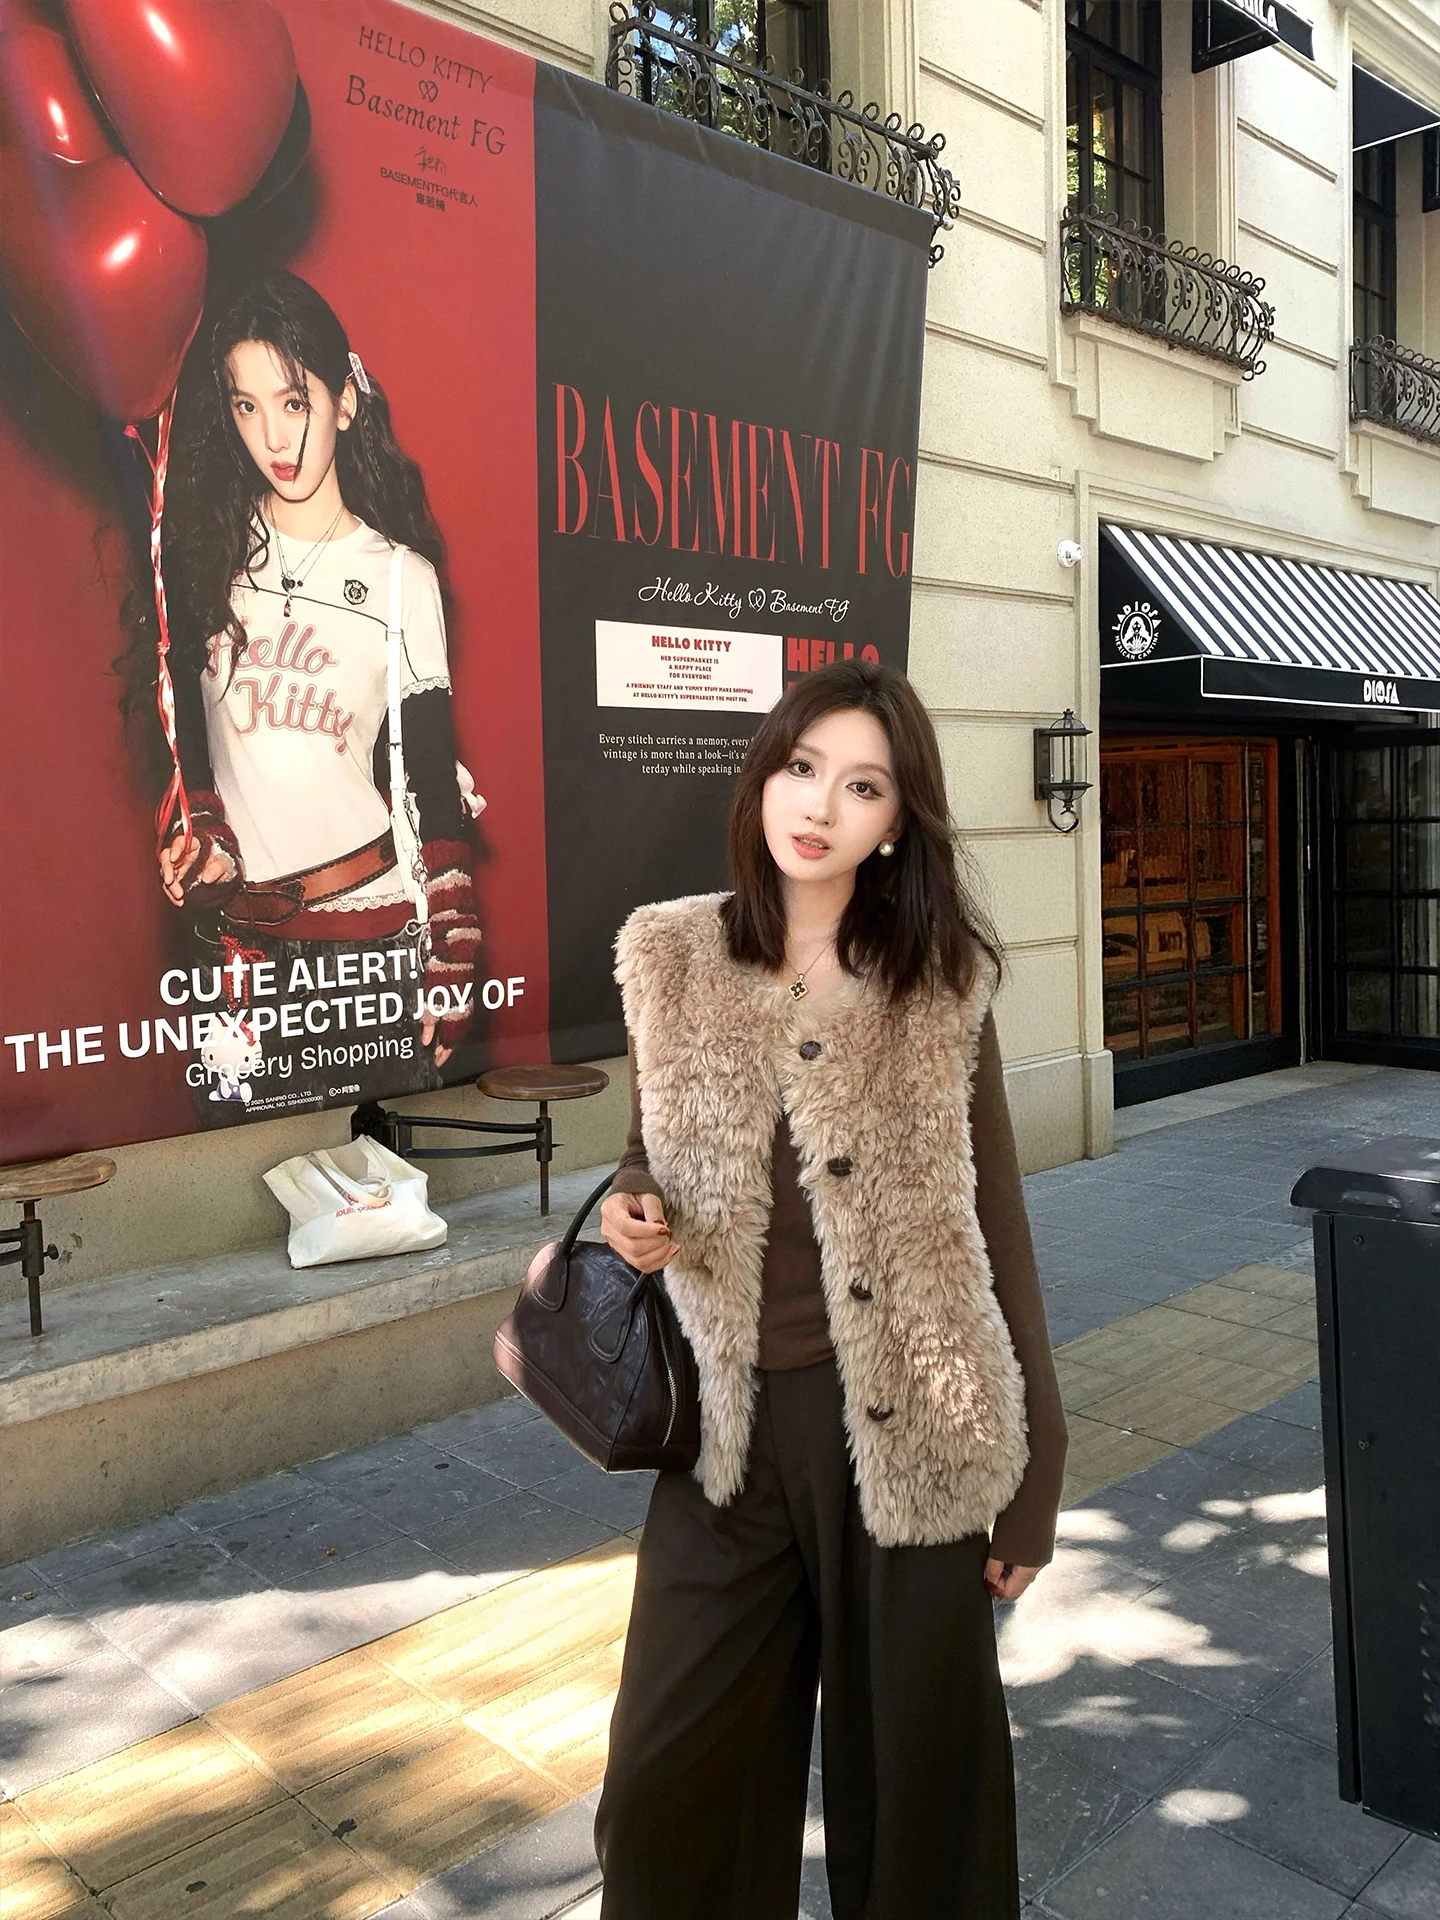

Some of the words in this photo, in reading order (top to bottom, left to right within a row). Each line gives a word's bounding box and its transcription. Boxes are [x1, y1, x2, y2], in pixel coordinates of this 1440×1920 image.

[358, 26, 425, 67] HELLO
[433, 55, 492, 93] KITTY
[346, 74, 461, 140] Basement
[470, 119, 506, 155] FG
[552, 382, 840, 569] BASEMENT
[856, 447, 911, 578] FG
[638, 577, 693, 601] Hello
[694, 582, 742, 619] Kitty
[770, 589, 824, 614] Basement
[824, 599, 850, 623] FG
[652, 635, 690, 649] HELLO
[694, 639, 732, 652] KITTY
[673, 656, 712, 664] SUPERMARKET
[1115, 635, 1136, 660] MEXICAN
[1138, 632, 1159, 660] CANTINA
[232, 672, 355, 755] Kitty
[599, 733, 625, 747] Every
[627, 734, 653, 745] stitch
[656, 735, 687, 745] carries
[688, 737, 694, 745] a
[696, 737, 730, 748] memory,
[731, 737, 749, 748] every
[603, 749, 637, 762] vintage
[640, 749, 648, 759] is
[651, 751, 673, 760] more
[675, 750, 695, 760] than
[697, 752, 703, 760] a
[642, 764, 669, 776] terday
[672, 764, 696, 774] while
[698, 764, 732, 776] speaking
[159, 961, 278, 1006] CUTE
[288, 948, 418, 993] ALERT!
[4, 1025, 105, 1073] THE
[118, 991, 404, 1058] UNEXPECTED
[412, 982, 474, 1021] JOY
[482, 976, 526, 1011] OF
[185, 1051, 293, 1088] Grocery
[300, 1035, 414, 1070] Shopping
[245, 1105, 275, 1113] APPROVAL
[265, 1095, 287, 1103] SANRIO
